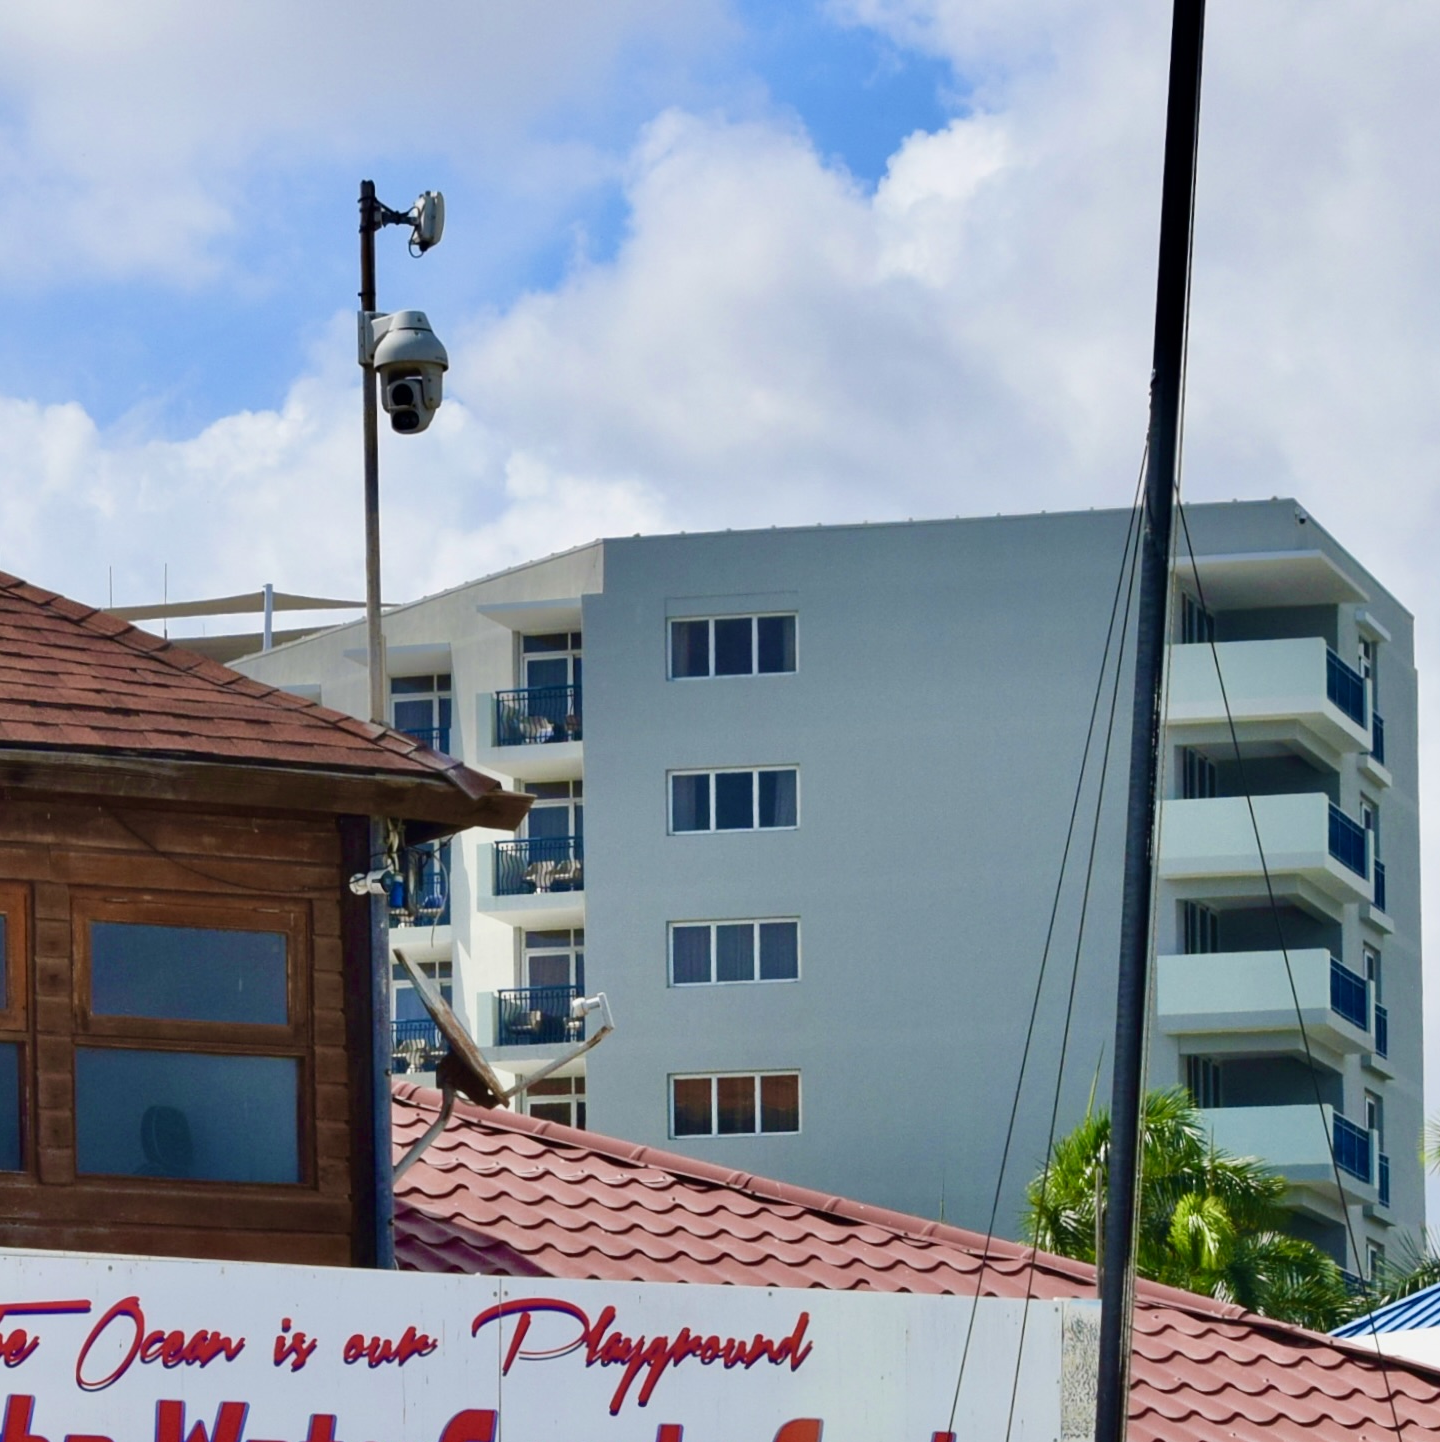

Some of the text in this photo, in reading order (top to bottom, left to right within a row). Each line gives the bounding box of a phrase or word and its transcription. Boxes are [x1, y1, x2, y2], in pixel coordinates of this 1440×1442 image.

[76, 1296, 245, 1392] Ocean
[273, 1317, 317, 1372] is
[342, 1326, 437, 1368] our
[472, 1297, 813, 1416] Playground
